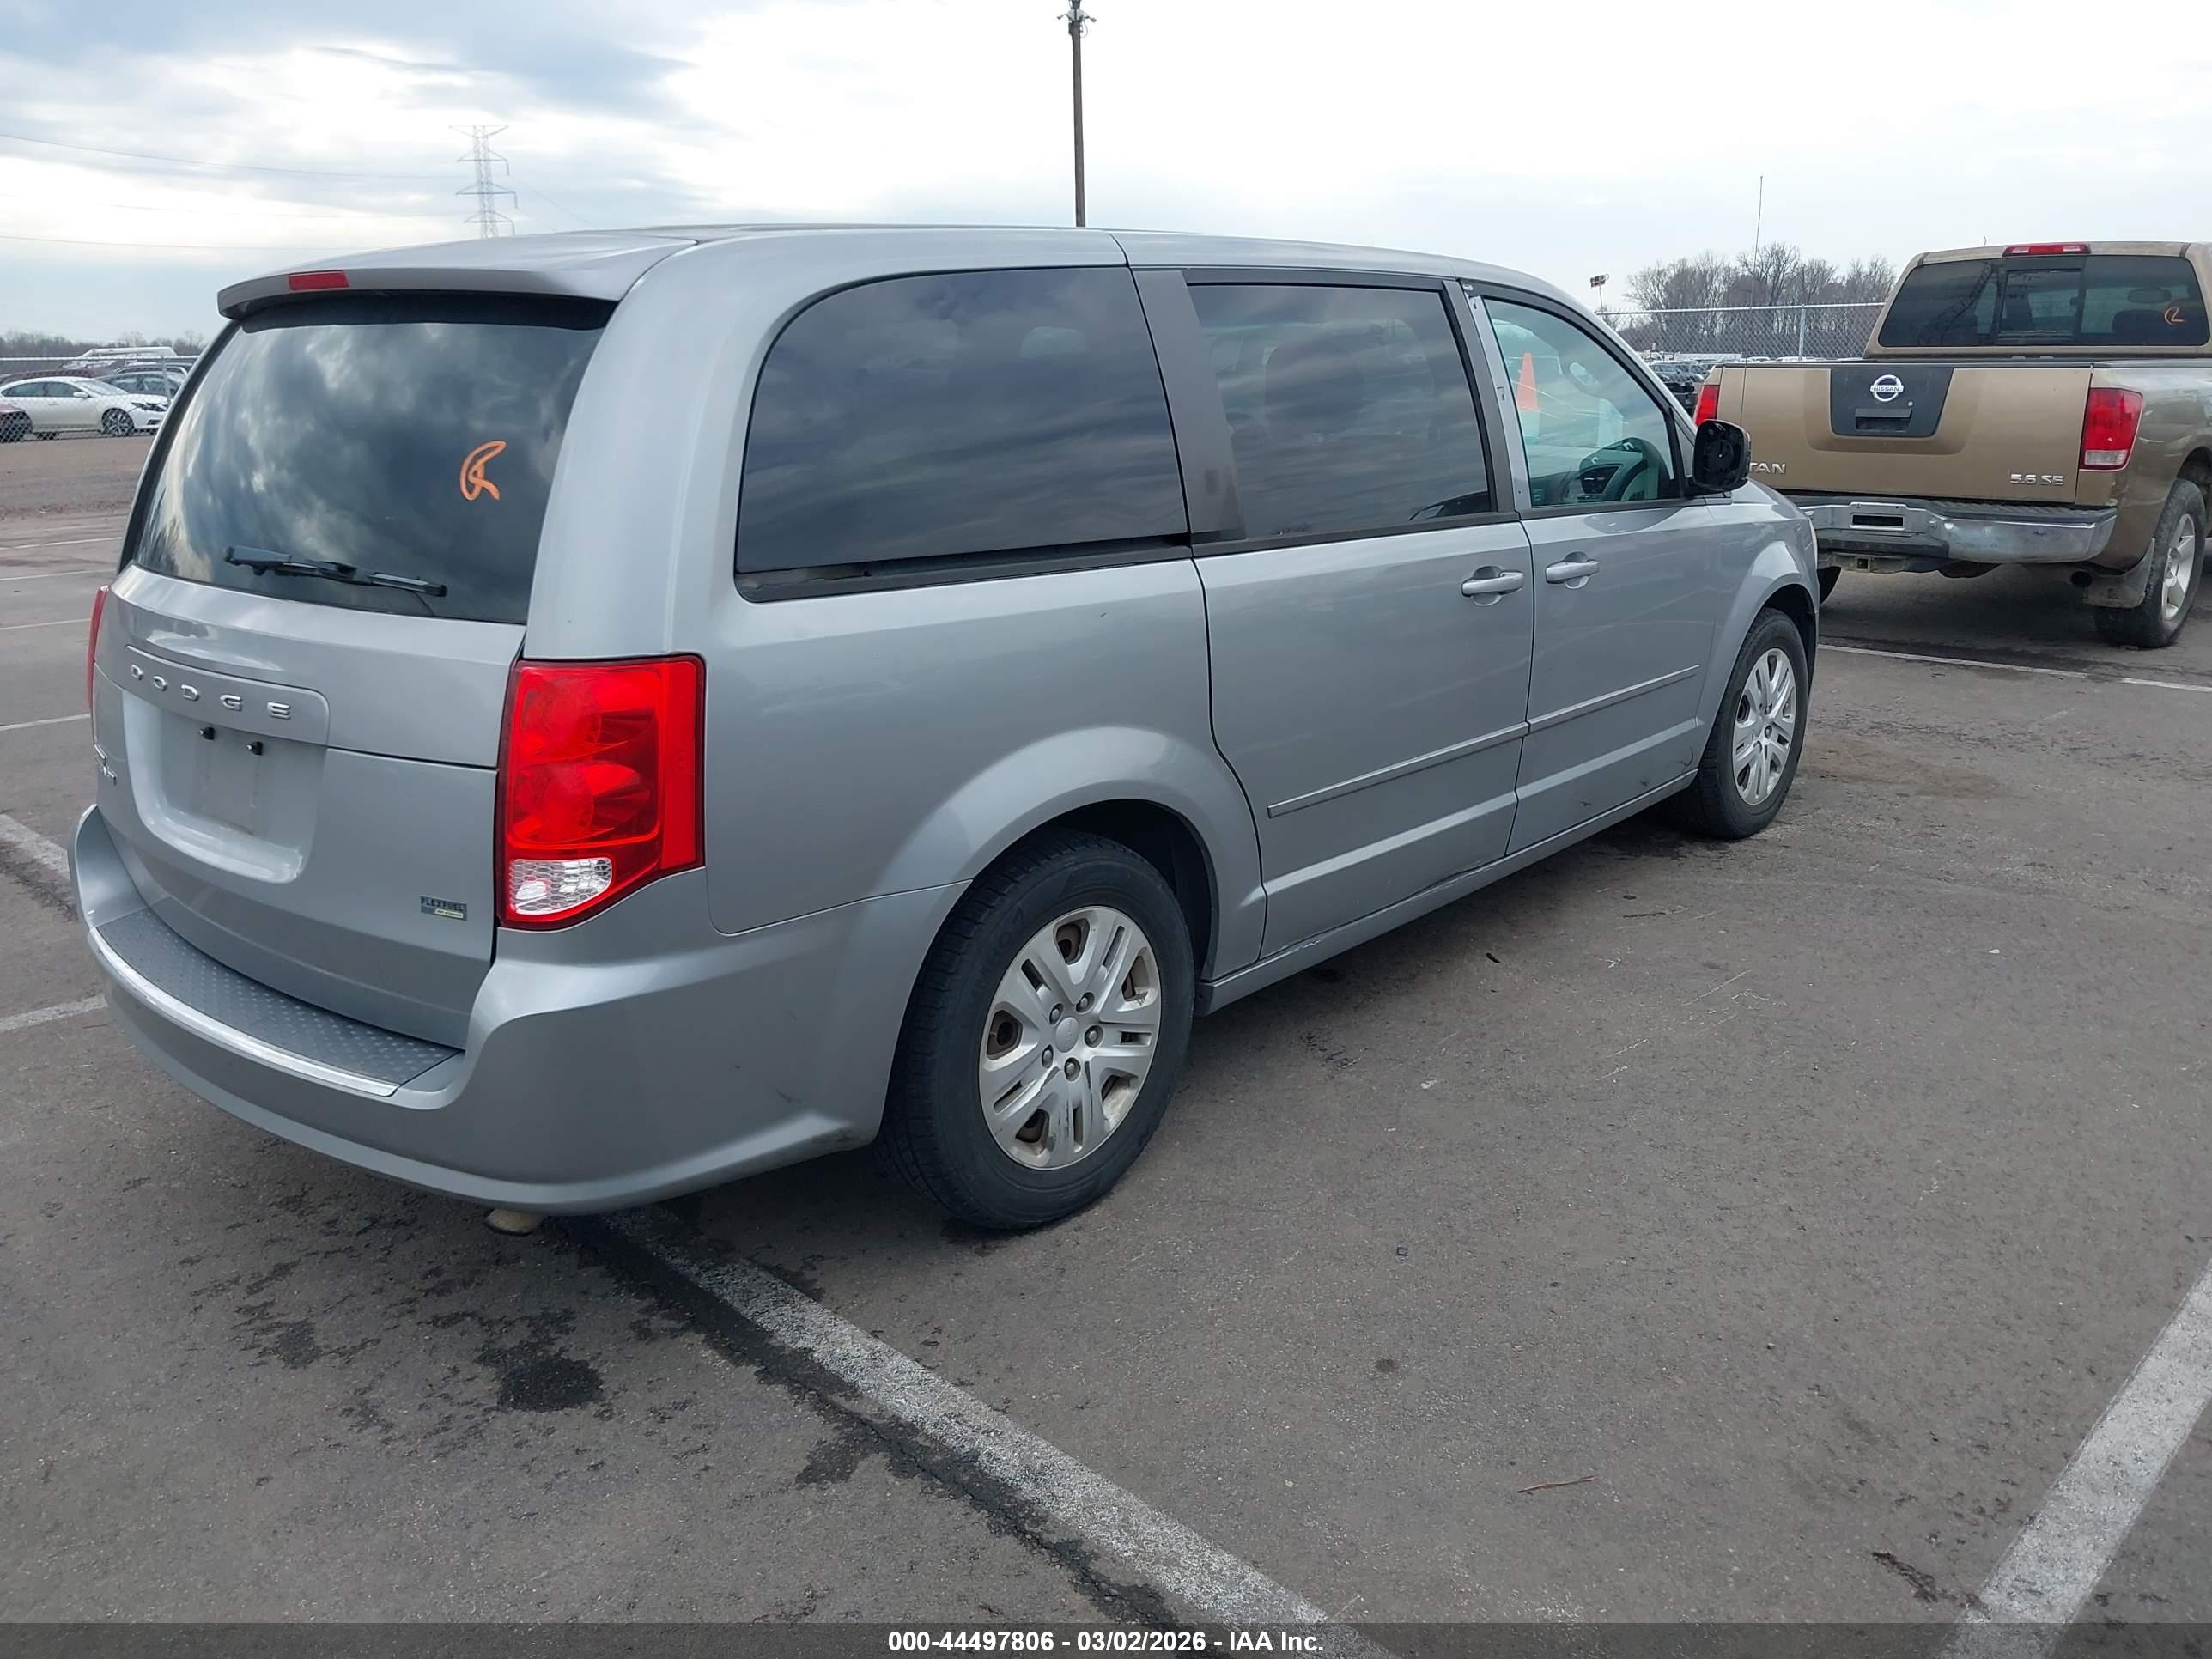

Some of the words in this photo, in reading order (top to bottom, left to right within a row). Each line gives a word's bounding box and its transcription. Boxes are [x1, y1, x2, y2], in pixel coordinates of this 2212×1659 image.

[1749, 462, 1786, 474] TAN
[2039, 475, 2064, 486] SE
[131, 664, 292, 720] DODGE
